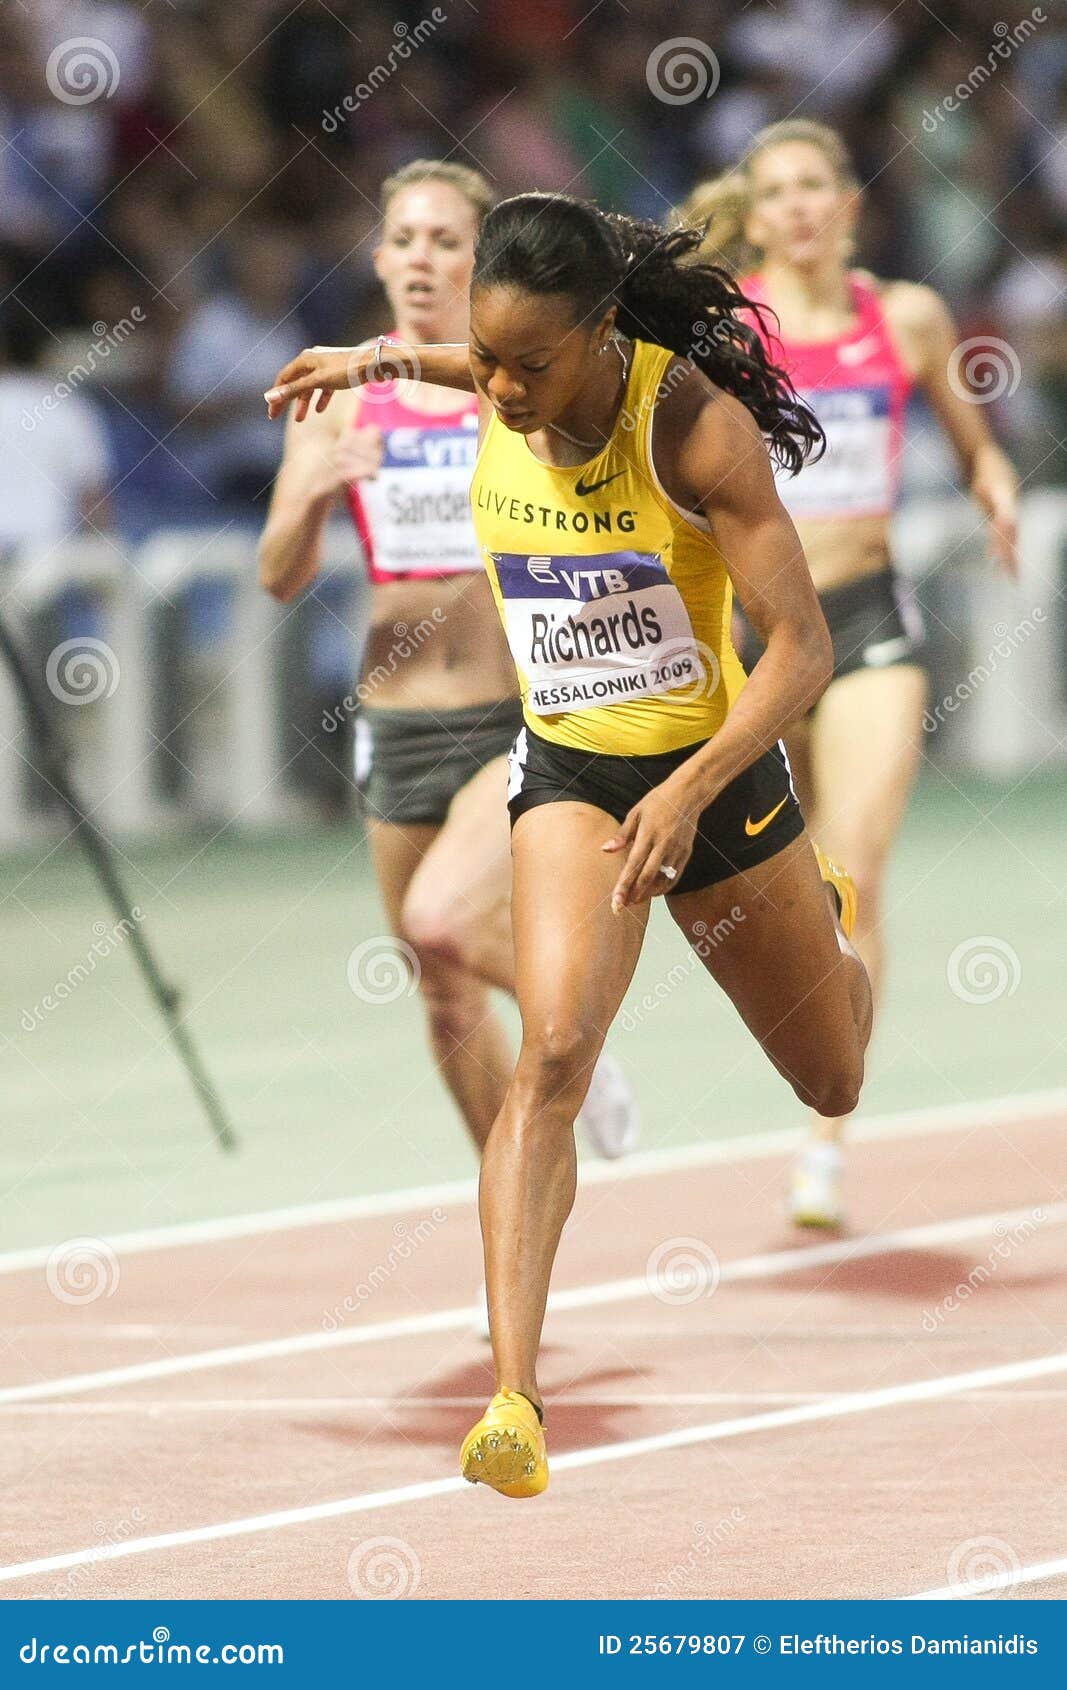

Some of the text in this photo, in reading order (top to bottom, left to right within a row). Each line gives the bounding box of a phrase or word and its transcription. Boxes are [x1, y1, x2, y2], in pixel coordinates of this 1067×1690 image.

[386, 482, 468, 525] Sande
[560, 569, 629, 598] VTB
[531, 600, 663, 664] Richards
[534, 657, 693, 707] HESSALONIKI 2009
